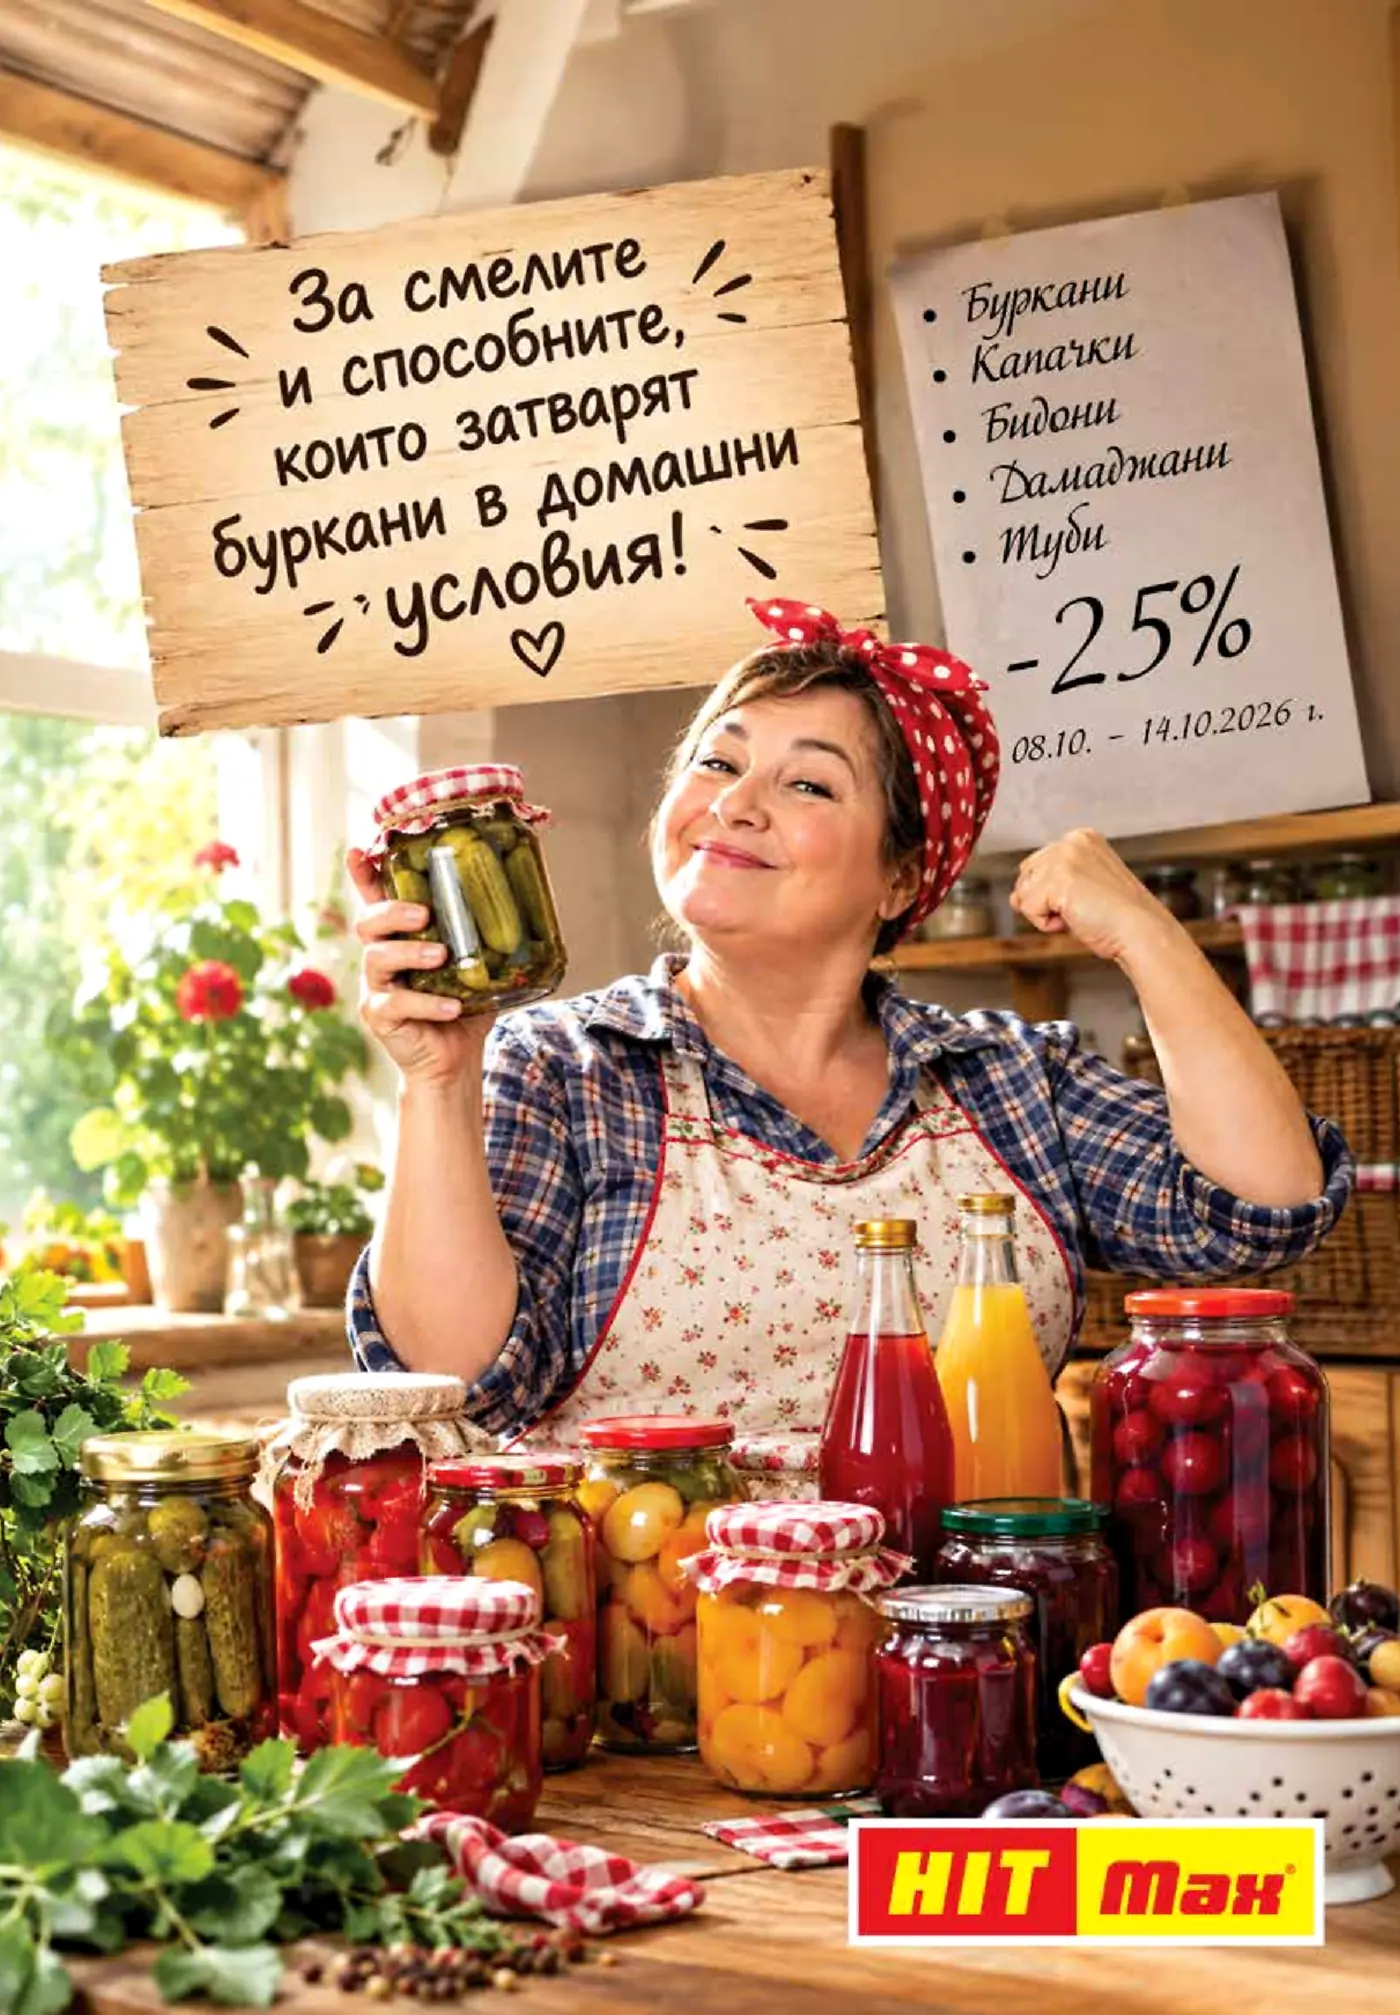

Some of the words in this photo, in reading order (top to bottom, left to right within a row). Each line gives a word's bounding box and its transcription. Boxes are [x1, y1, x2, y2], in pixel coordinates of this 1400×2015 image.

[289, 267, 374, 333] За
[405, 236, 647, 313] смелите
[962, 271, 1129, 340] Буркани
[279, 366, 313, 409] и
[342, 304, 686, 397] способните,
[971, 330, 1139, 385] Капачки
[274, 420, 428, 487] които
[457, 367, 699, 446] затварят
[981, 396, 1121, 444] Бидони
[212, 497, 447, 595] буркани
[474, 484, 508, 528] в
[537, 427, 799, 528] домашни
[989, 440, 1232, 504] Дамаджани
[386, 510, 687, 657] условия!
[998, 502, 1107, 579] Туби
[1006, 563, 1252, 696] -25%
[1011, 728, 1092, 765] 08.10.
[1142, 698, 1292, 746] 14.10.2026
